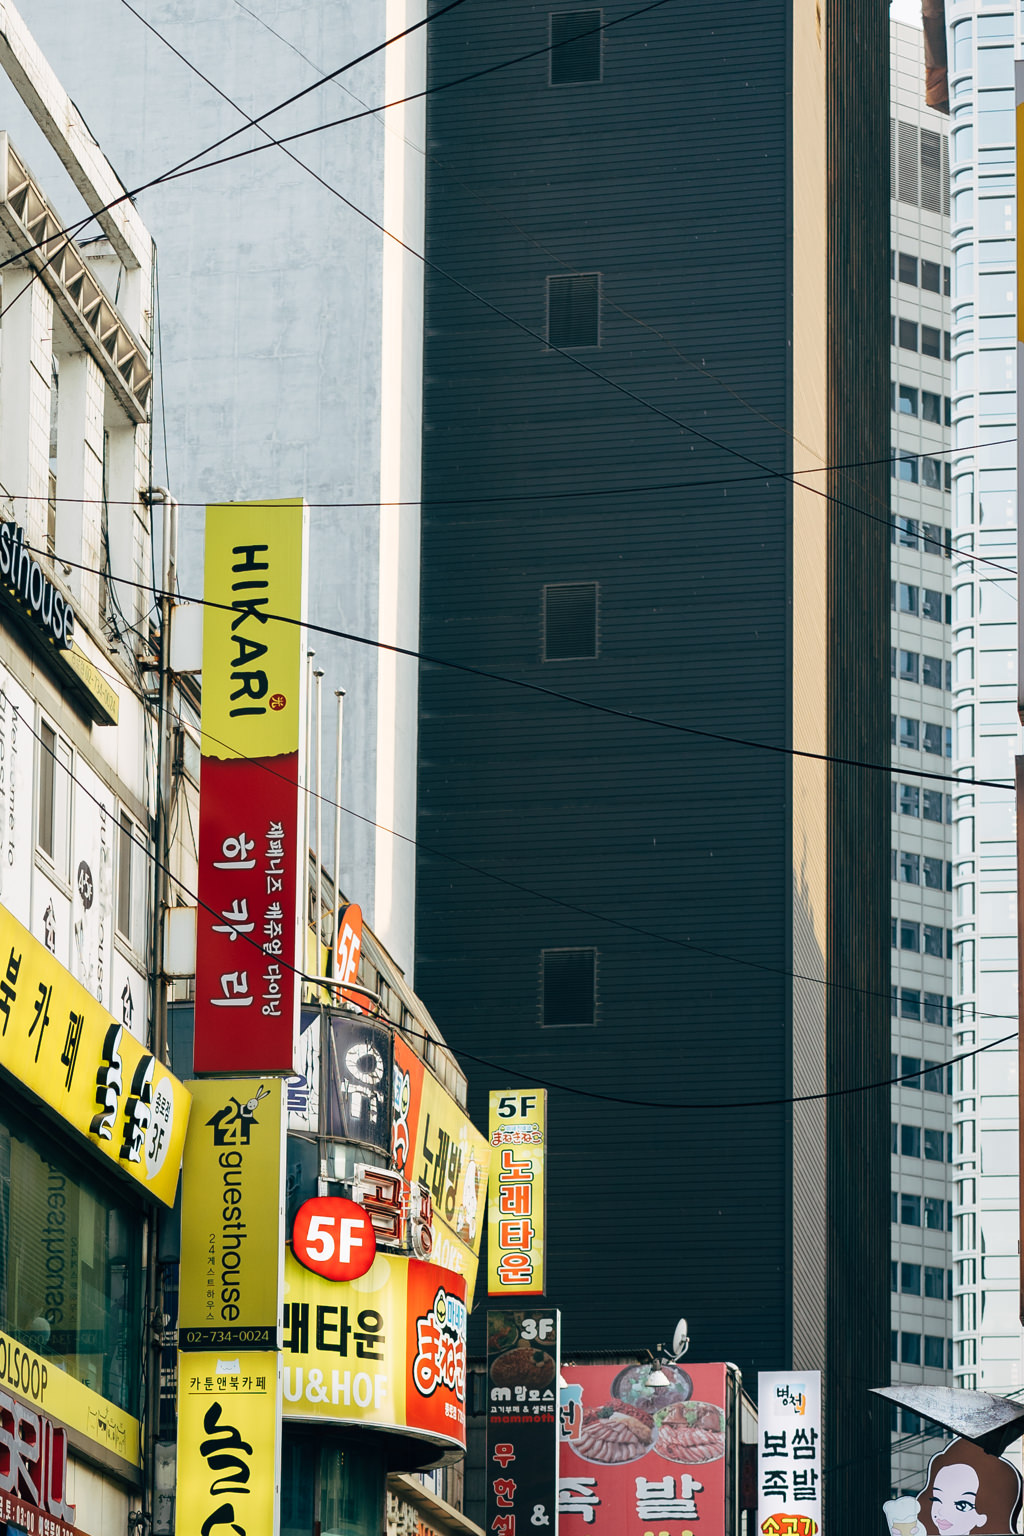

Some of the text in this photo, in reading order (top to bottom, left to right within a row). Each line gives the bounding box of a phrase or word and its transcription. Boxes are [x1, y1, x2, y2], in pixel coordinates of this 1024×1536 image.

[229, 544, 269, 717] HIKARI
[210, 832, 257, 1007] 히카리
[261, 820, 286, 1016] 재패니즈 캐쥬얼 다이닝
[336, 923, 362, 991] 5F
[218, 1102, 248, 1146] 24
[497, 1096, 536, 1119] 5F
[148, 1123, 165, 1163] 3F
[418, 1112, 464, 1222] 노래방
[499, 1149, 535, 1285] 노래타운
[218, 1151, 248, 1321] guesthouse
[305, 1215, 365, 1264] 5F
[186, 1329, 269, 1343] 02-734-0024
[520, 1318, 553, 1341] 3F
[189, 1376, 267, 1391] 카툰앤북카페
[514, 1385, 555, 1401] 맘모스
[776, 1384, 803, 1415] 병천
[490, 1412, 555, 1423] mammoth
[762, 1427, 818, 1460] 보쌈
[762, 1468, 818, 1503] 족발
[530, 1504, 550, 1526] &
